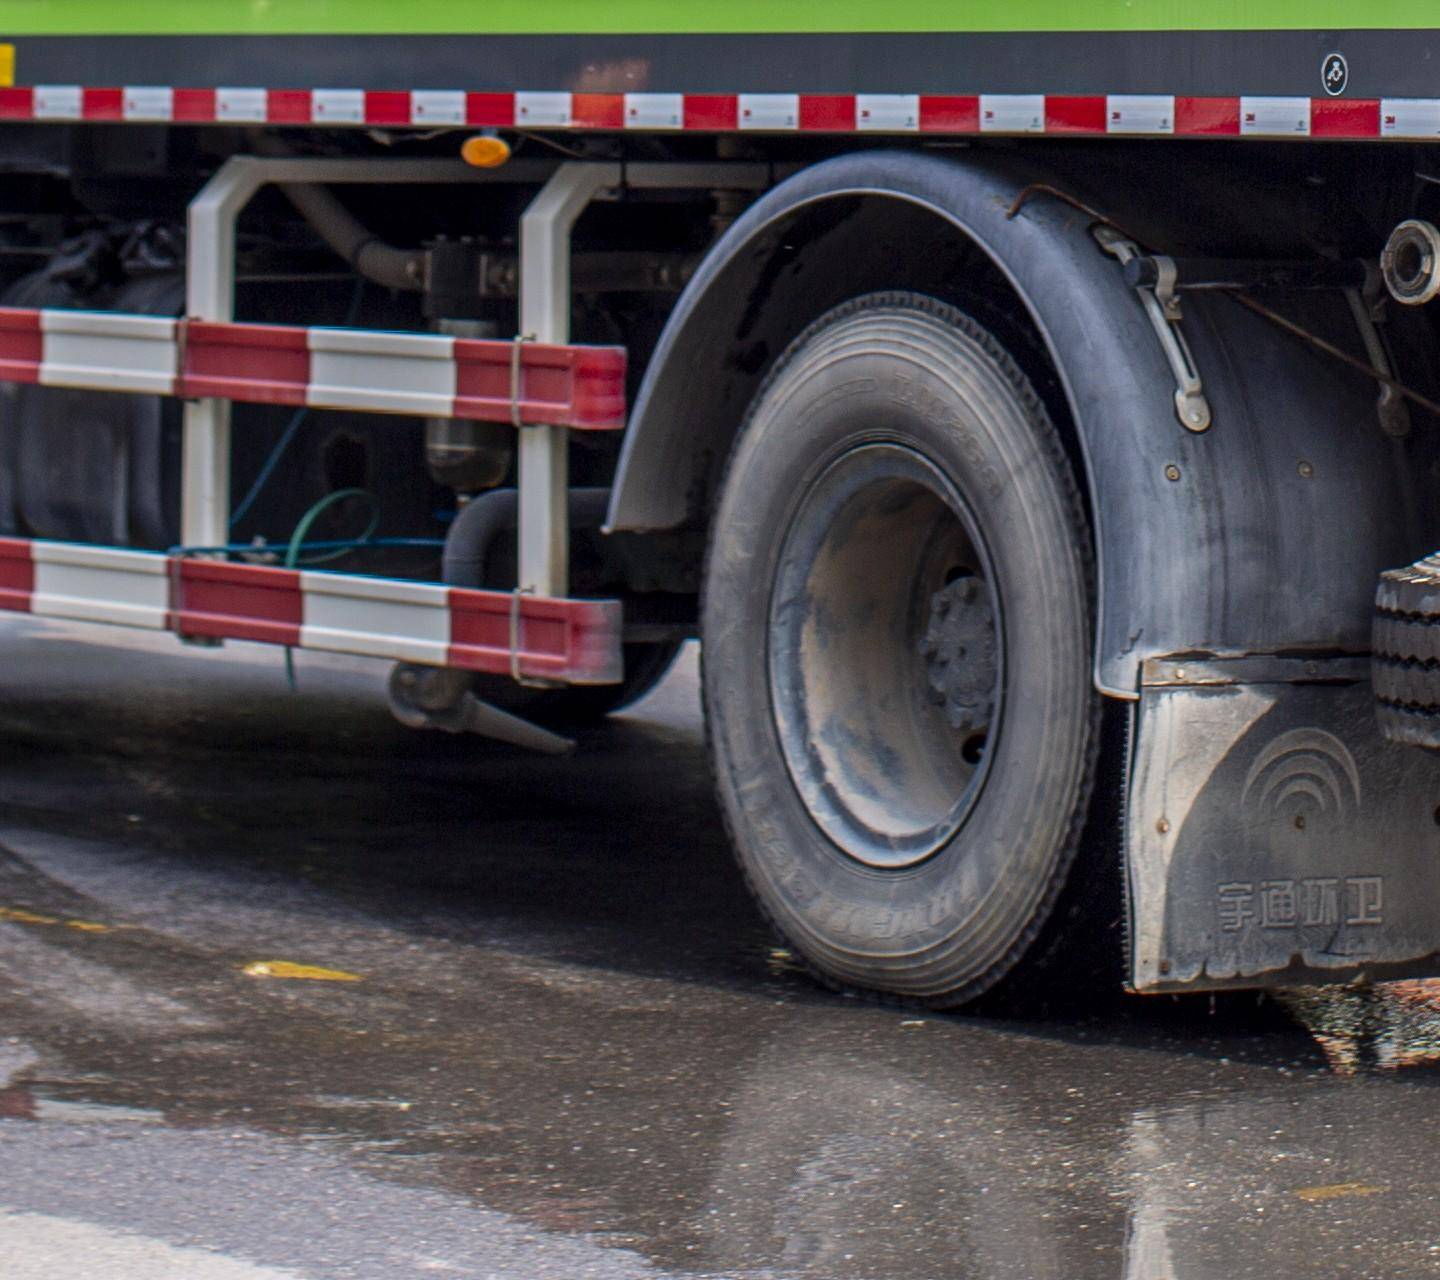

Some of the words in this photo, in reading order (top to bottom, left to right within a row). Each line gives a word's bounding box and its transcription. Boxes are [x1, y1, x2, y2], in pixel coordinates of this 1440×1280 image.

[1245, 113, 1256, 123] 3M
[1385, 115, 1396, 125] 3M
[1216, 875, 1385, 933] 宇通环卫
